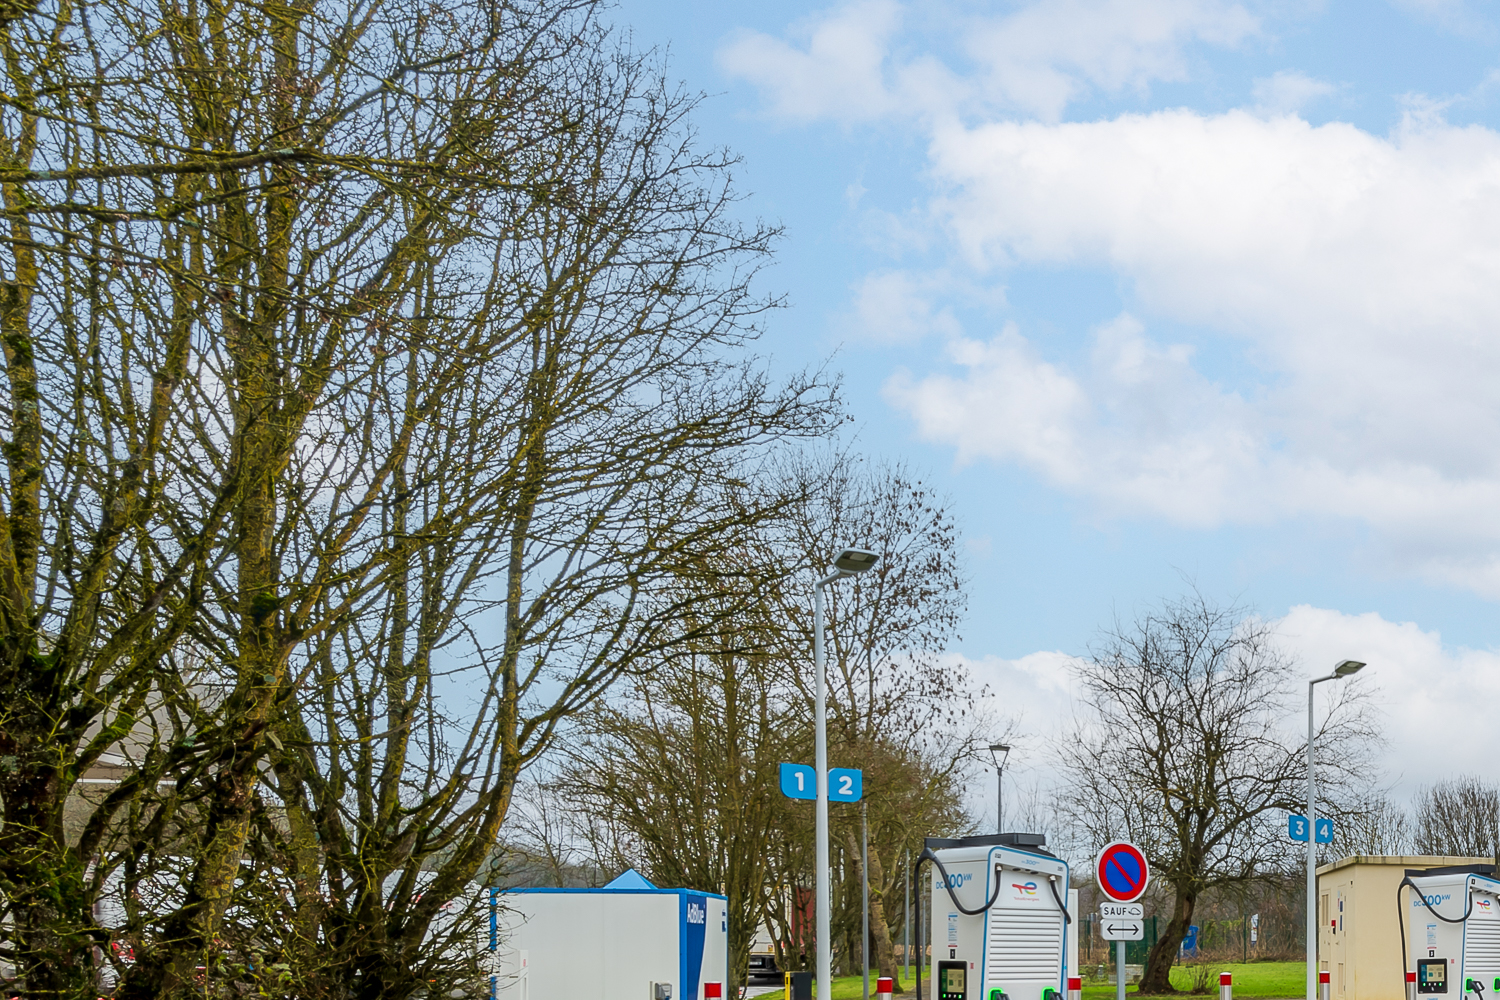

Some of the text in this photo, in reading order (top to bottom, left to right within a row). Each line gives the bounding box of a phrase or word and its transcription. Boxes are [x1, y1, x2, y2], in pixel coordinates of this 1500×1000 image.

[794, 772, 804, 792] 1
[838, 775, 853, 795] 2
[1295, 820, 1304, 836] 3
[1320, 824, 1329, 838] 4
[1103, 907, 1127, 916] SAUF
